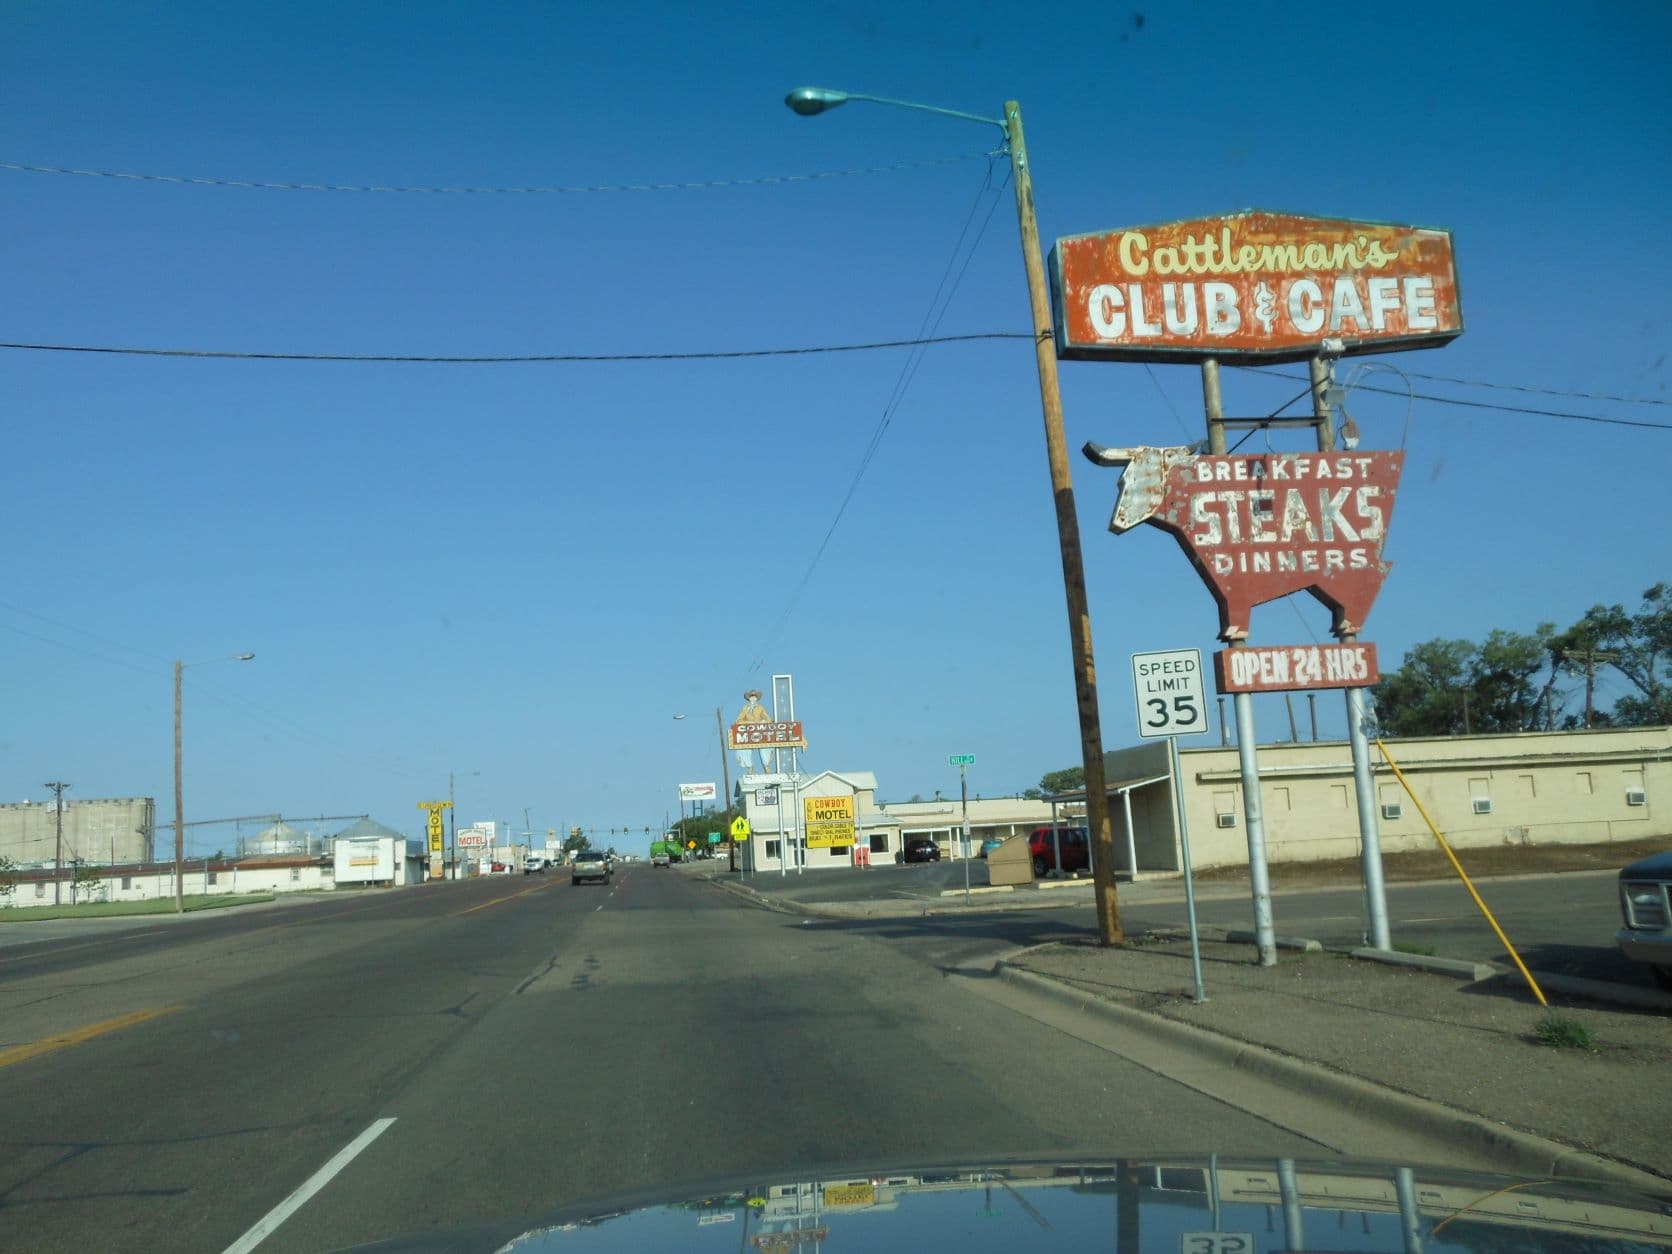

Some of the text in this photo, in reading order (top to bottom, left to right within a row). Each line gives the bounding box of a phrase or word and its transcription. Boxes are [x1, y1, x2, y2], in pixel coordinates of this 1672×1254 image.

[1119, 228, 1399, 276] Cattleman's
[1088, 280, 1241, 339] CLUB
[1287, 276, 1438, 334] CAFE
[1198, 457, 1373, 483] BREAKFAST
[1192, 486, 1384, 547] STEAKS
[1214, 548, 1369, 575] DINNERS
[1139, 660, 1195, 676] SPEED
[1231, 648, 1368, 686] OPEN 24 HRS
[1146, 677, 1191, 693] LIMIT
[1146, 695, 1198, 728] 35
[736, 730, 800, 744] MOTEL
[814, 798, 846, 809] COWBOY
[815, 808, 852, 820] MOTEL
[430, 808, 440, 851] MOTEL
[458, 836, 485, 845] MOTEL
